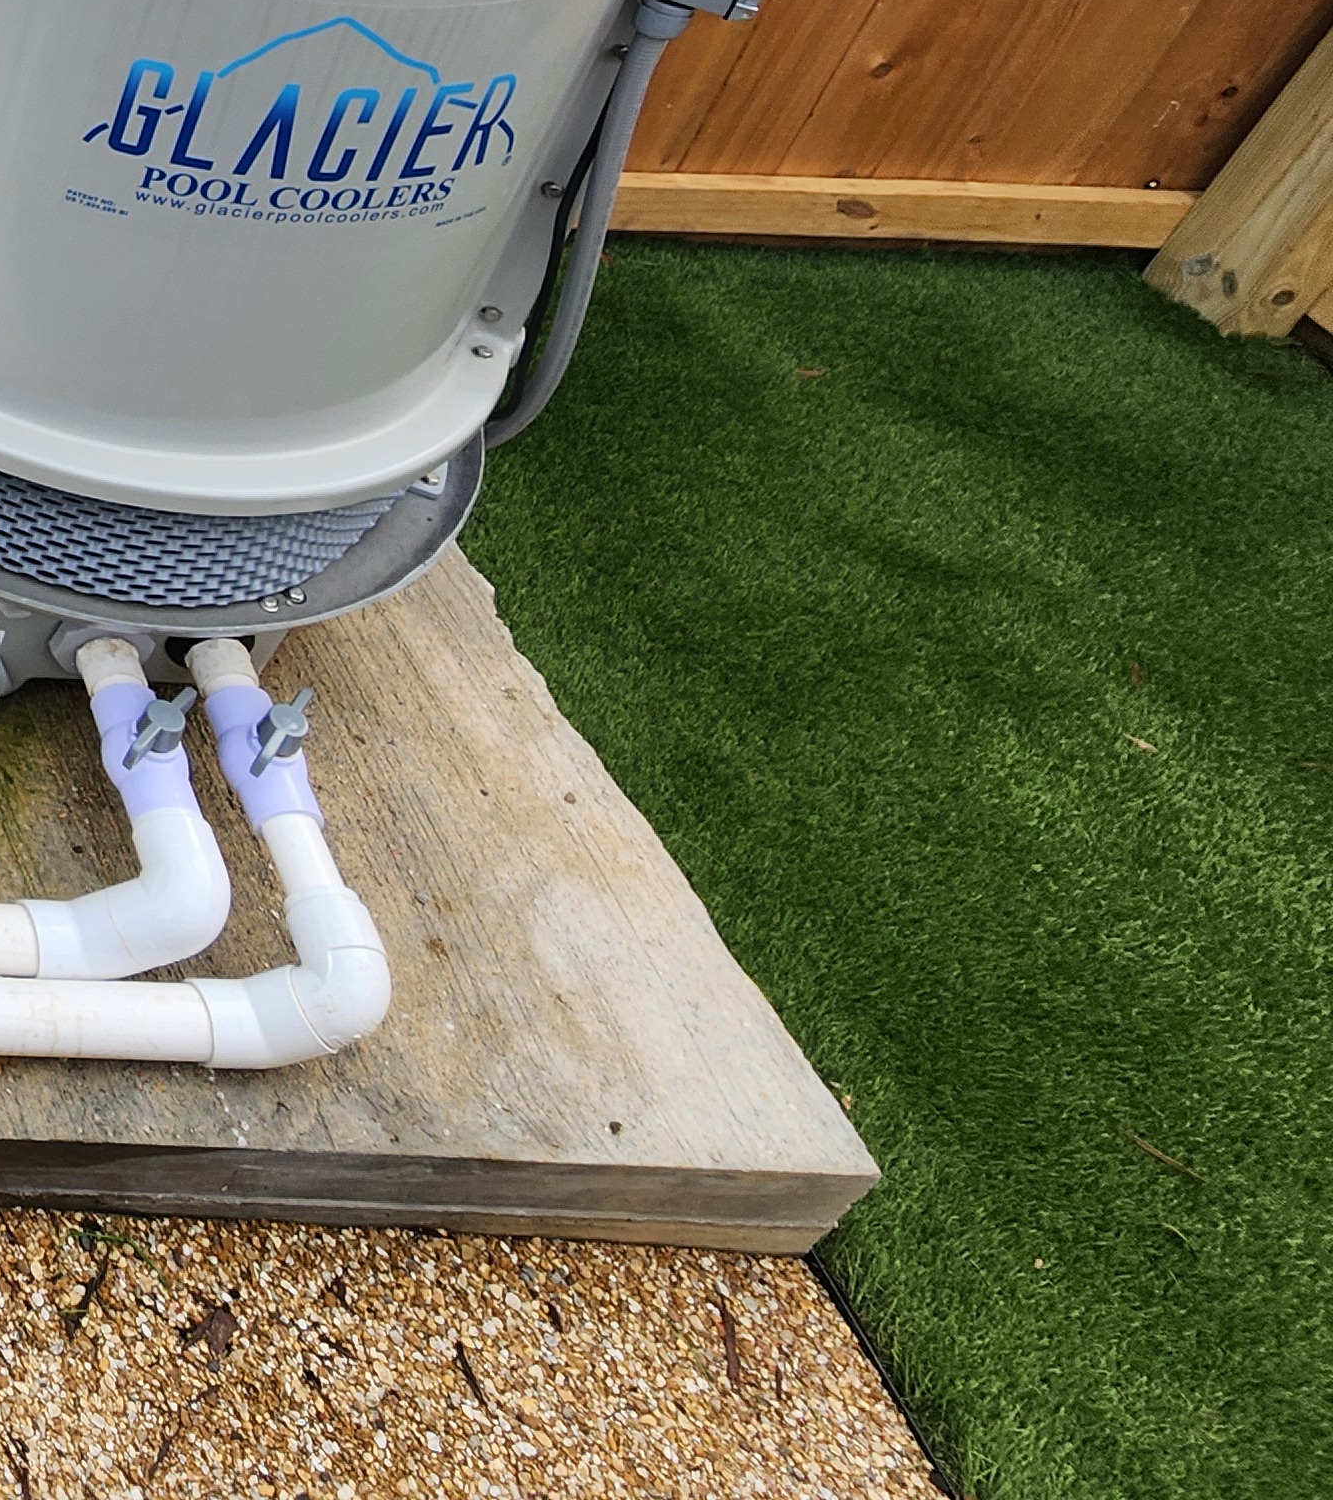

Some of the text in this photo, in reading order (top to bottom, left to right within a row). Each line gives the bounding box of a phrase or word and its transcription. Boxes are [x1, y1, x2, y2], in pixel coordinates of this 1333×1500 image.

[84, 56, 517, 183] GLACIER
[66, 188, 99, 202] PATENT
[135, 190, 445, 225] www.glacierpoolcoolers.com
[139, 165, 457, 211] POOL COOLERS
